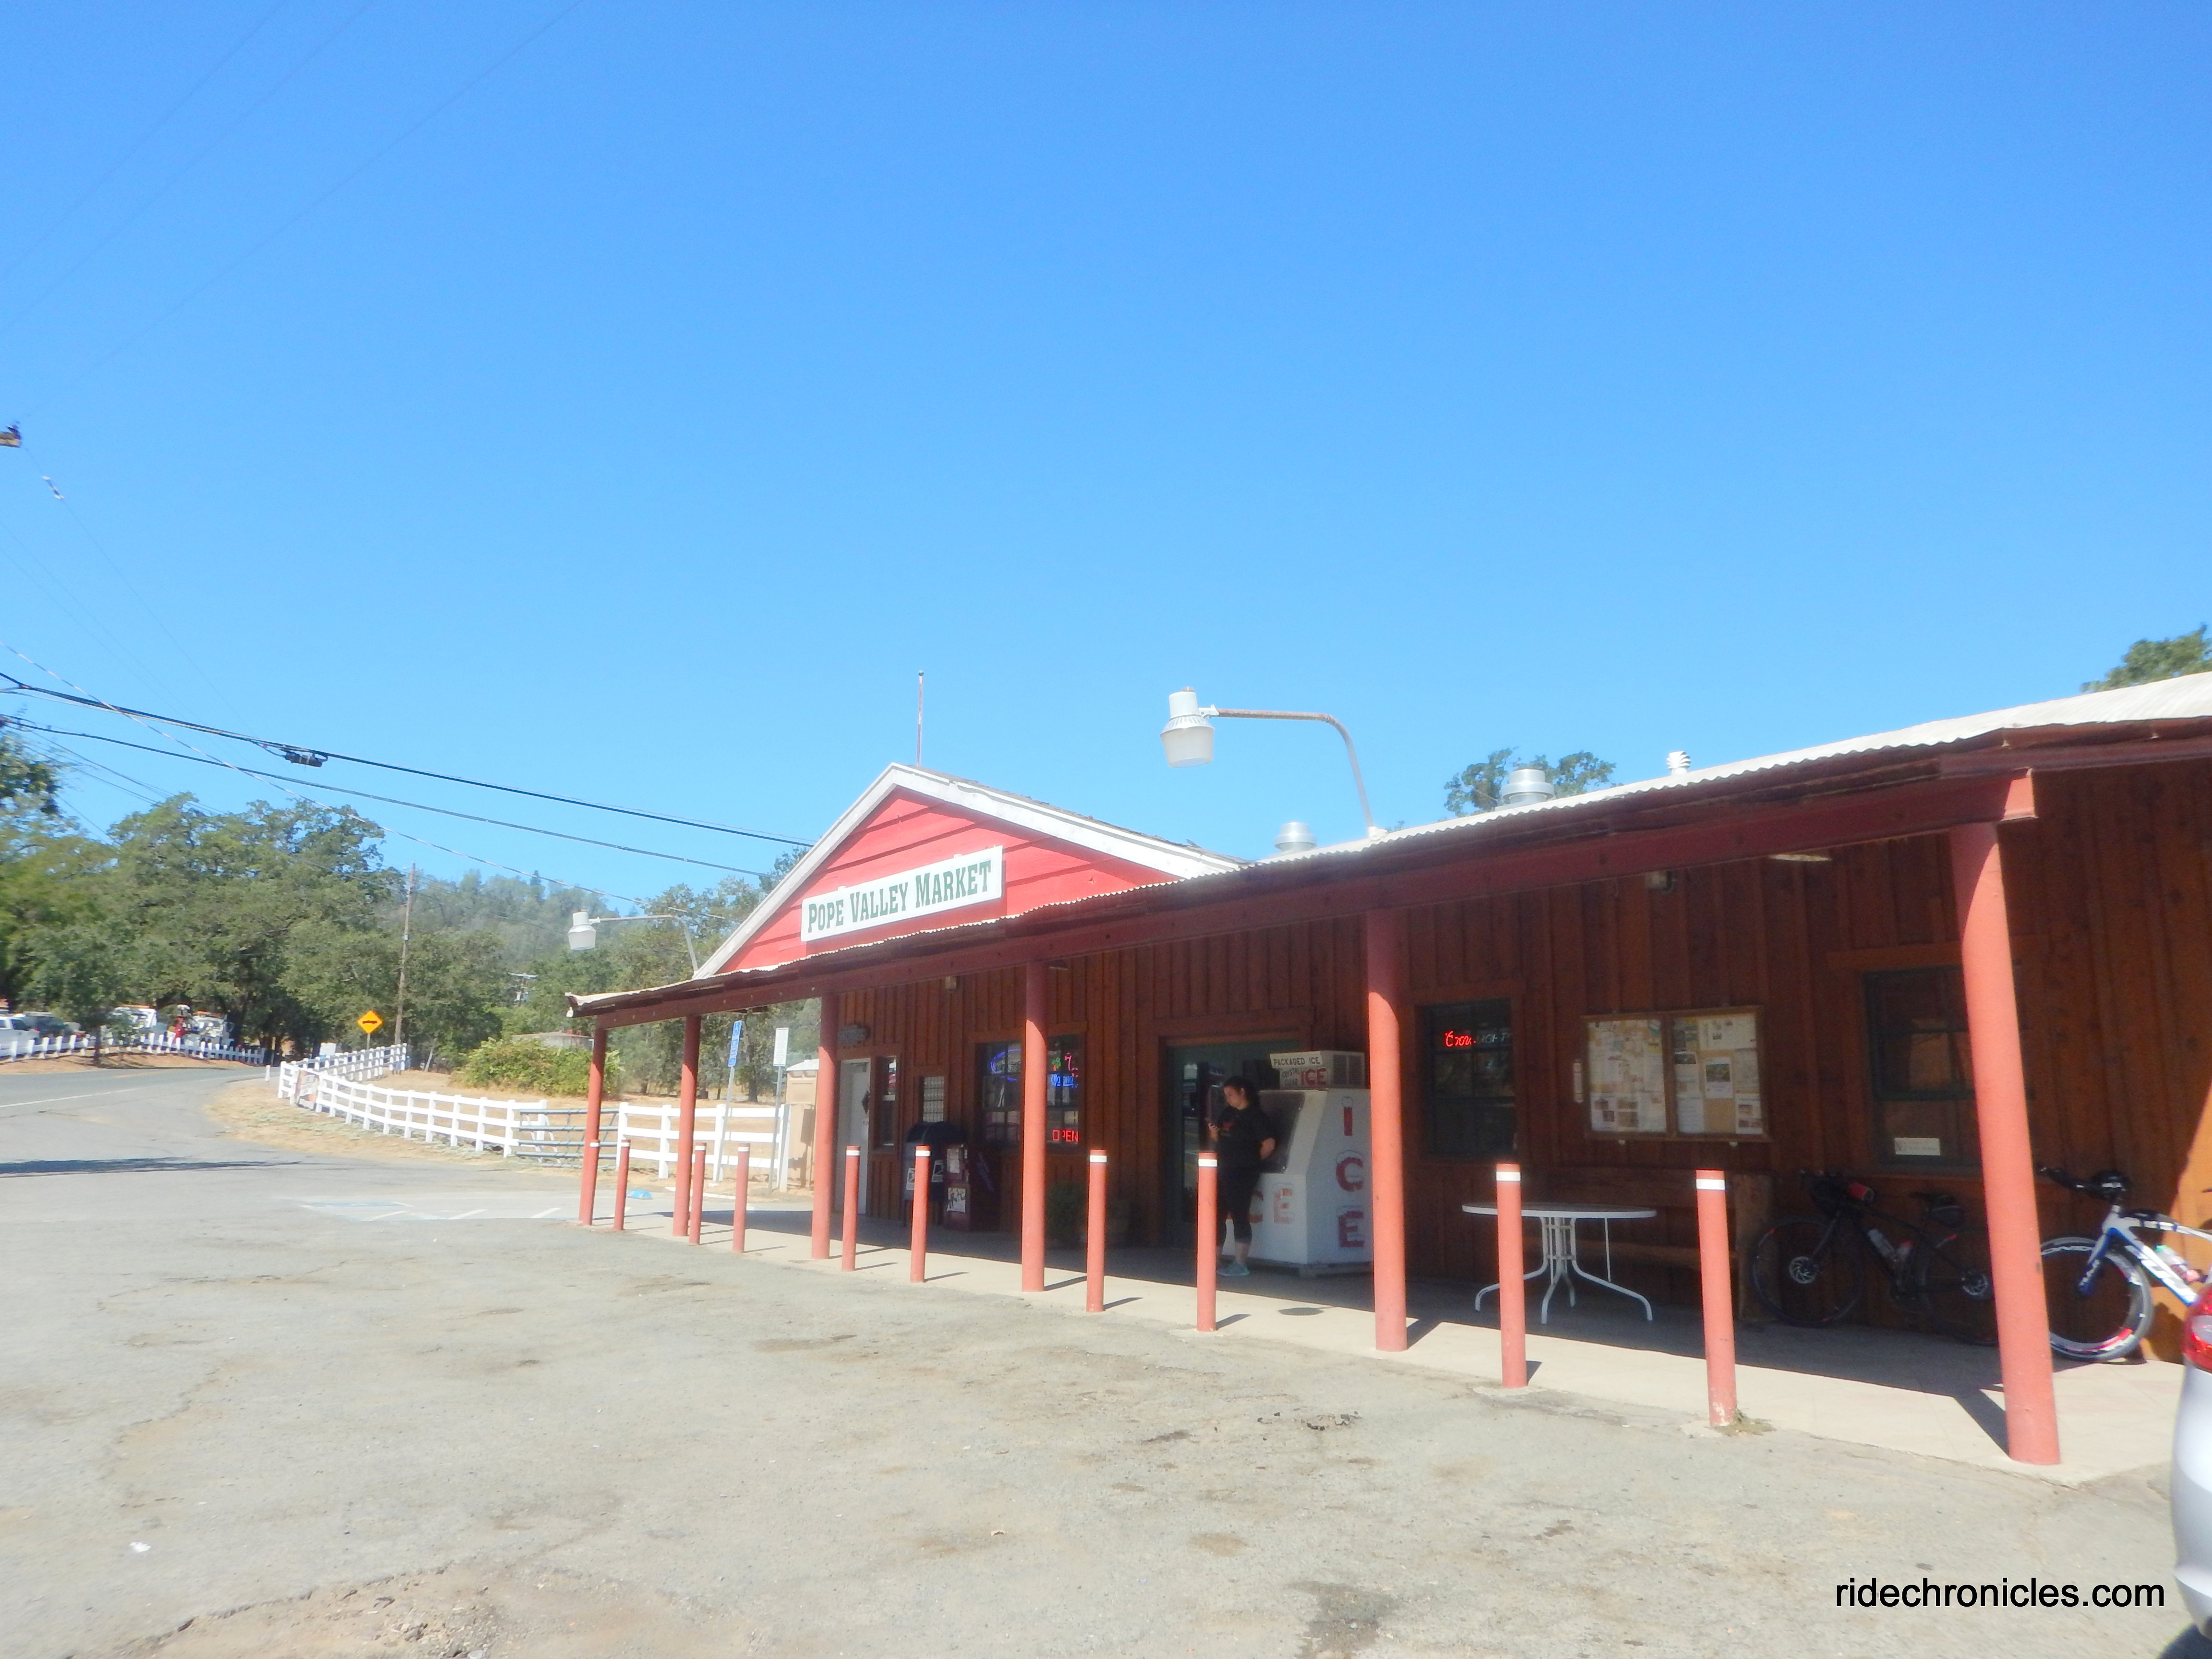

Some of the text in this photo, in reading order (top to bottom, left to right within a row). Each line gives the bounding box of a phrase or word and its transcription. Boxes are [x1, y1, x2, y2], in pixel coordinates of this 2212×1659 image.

[808, 860, 991, 933] POPE VALLEY MARKET
[1273, 1058, 1305, 1066] PACKAGED
[1300, 1068, 1327, 1087] ICE
[1336, 1100, 1365, 1248] ICE
